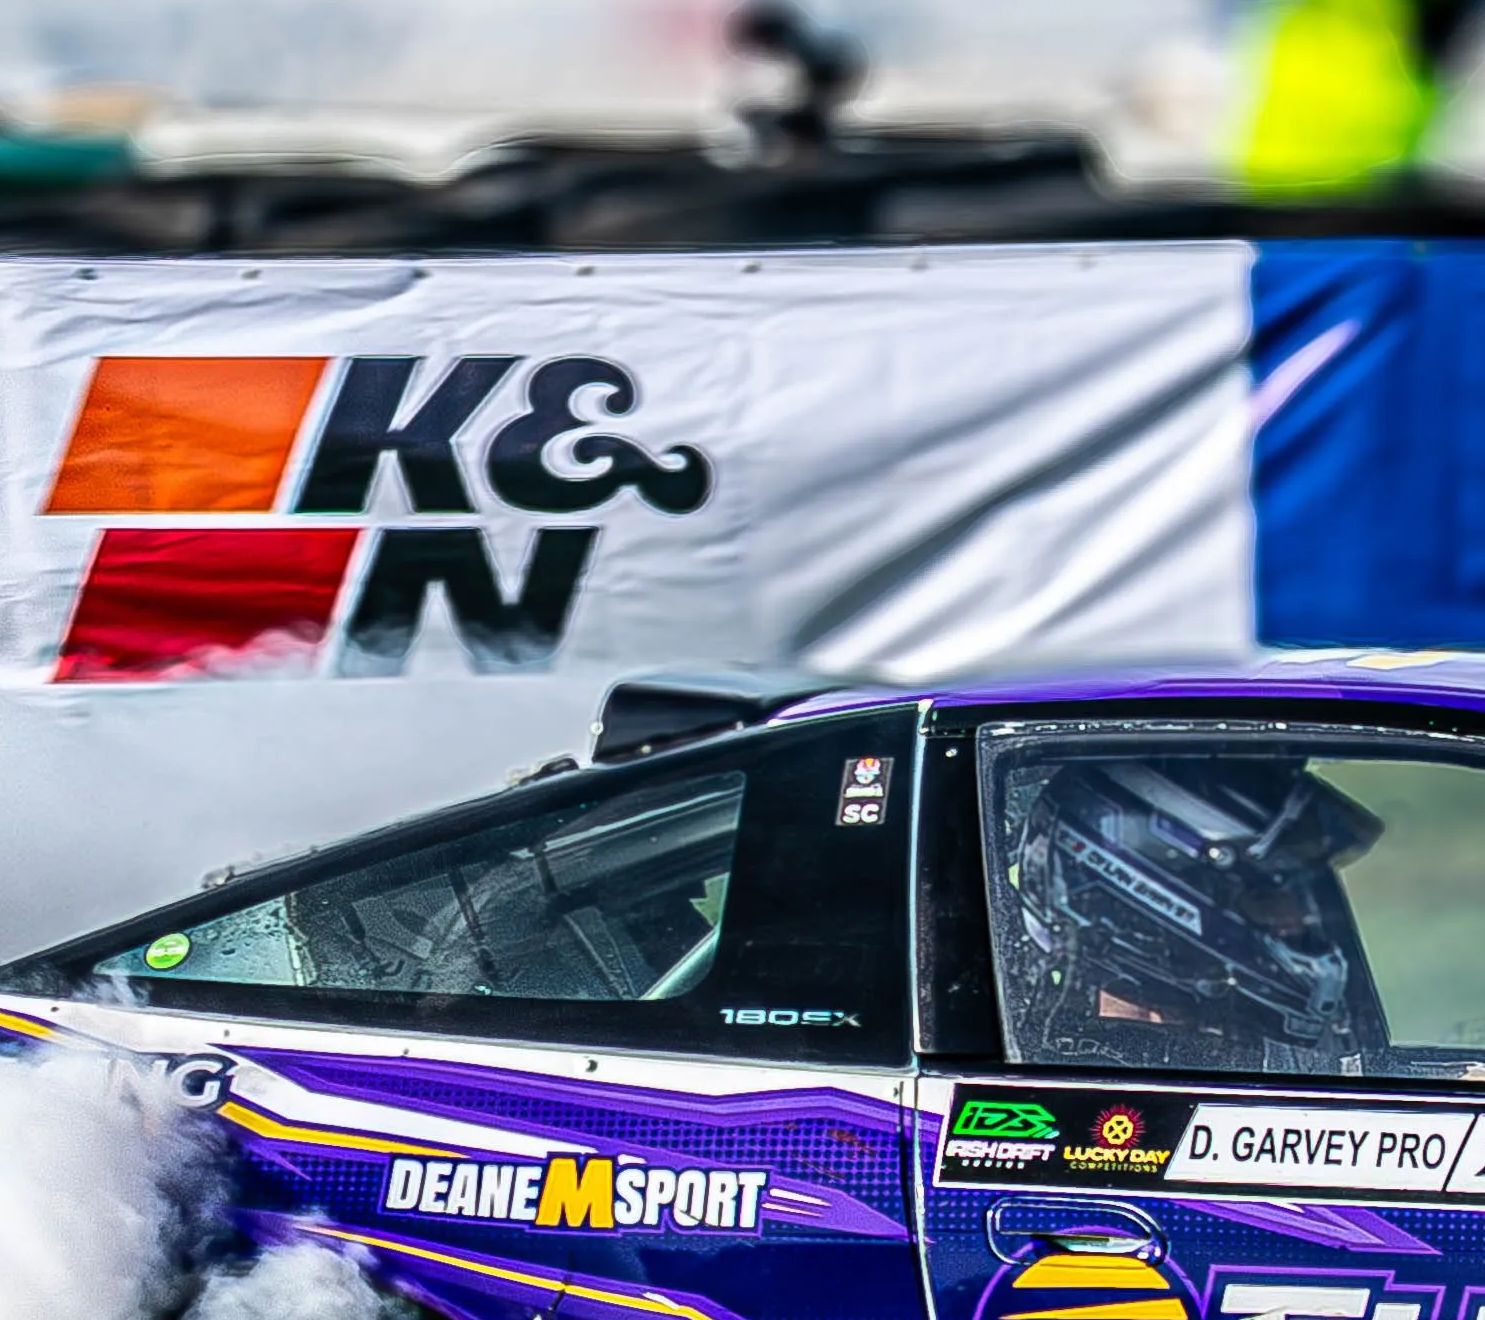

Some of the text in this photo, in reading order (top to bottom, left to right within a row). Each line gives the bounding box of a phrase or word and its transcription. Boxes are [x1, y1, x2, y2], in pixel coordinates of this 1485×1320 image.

[842, 803, 880, 824] SC
[719, 1008, 862, 1028] 180SX
[1063, 1146, 1170, 1165] LUCKY DAY
[1189, 1124, 1219, 1161] D.
[1231, 1125, 1371, 1167] GARVEY
[1376, 1131, 1447, 1170] PRO
